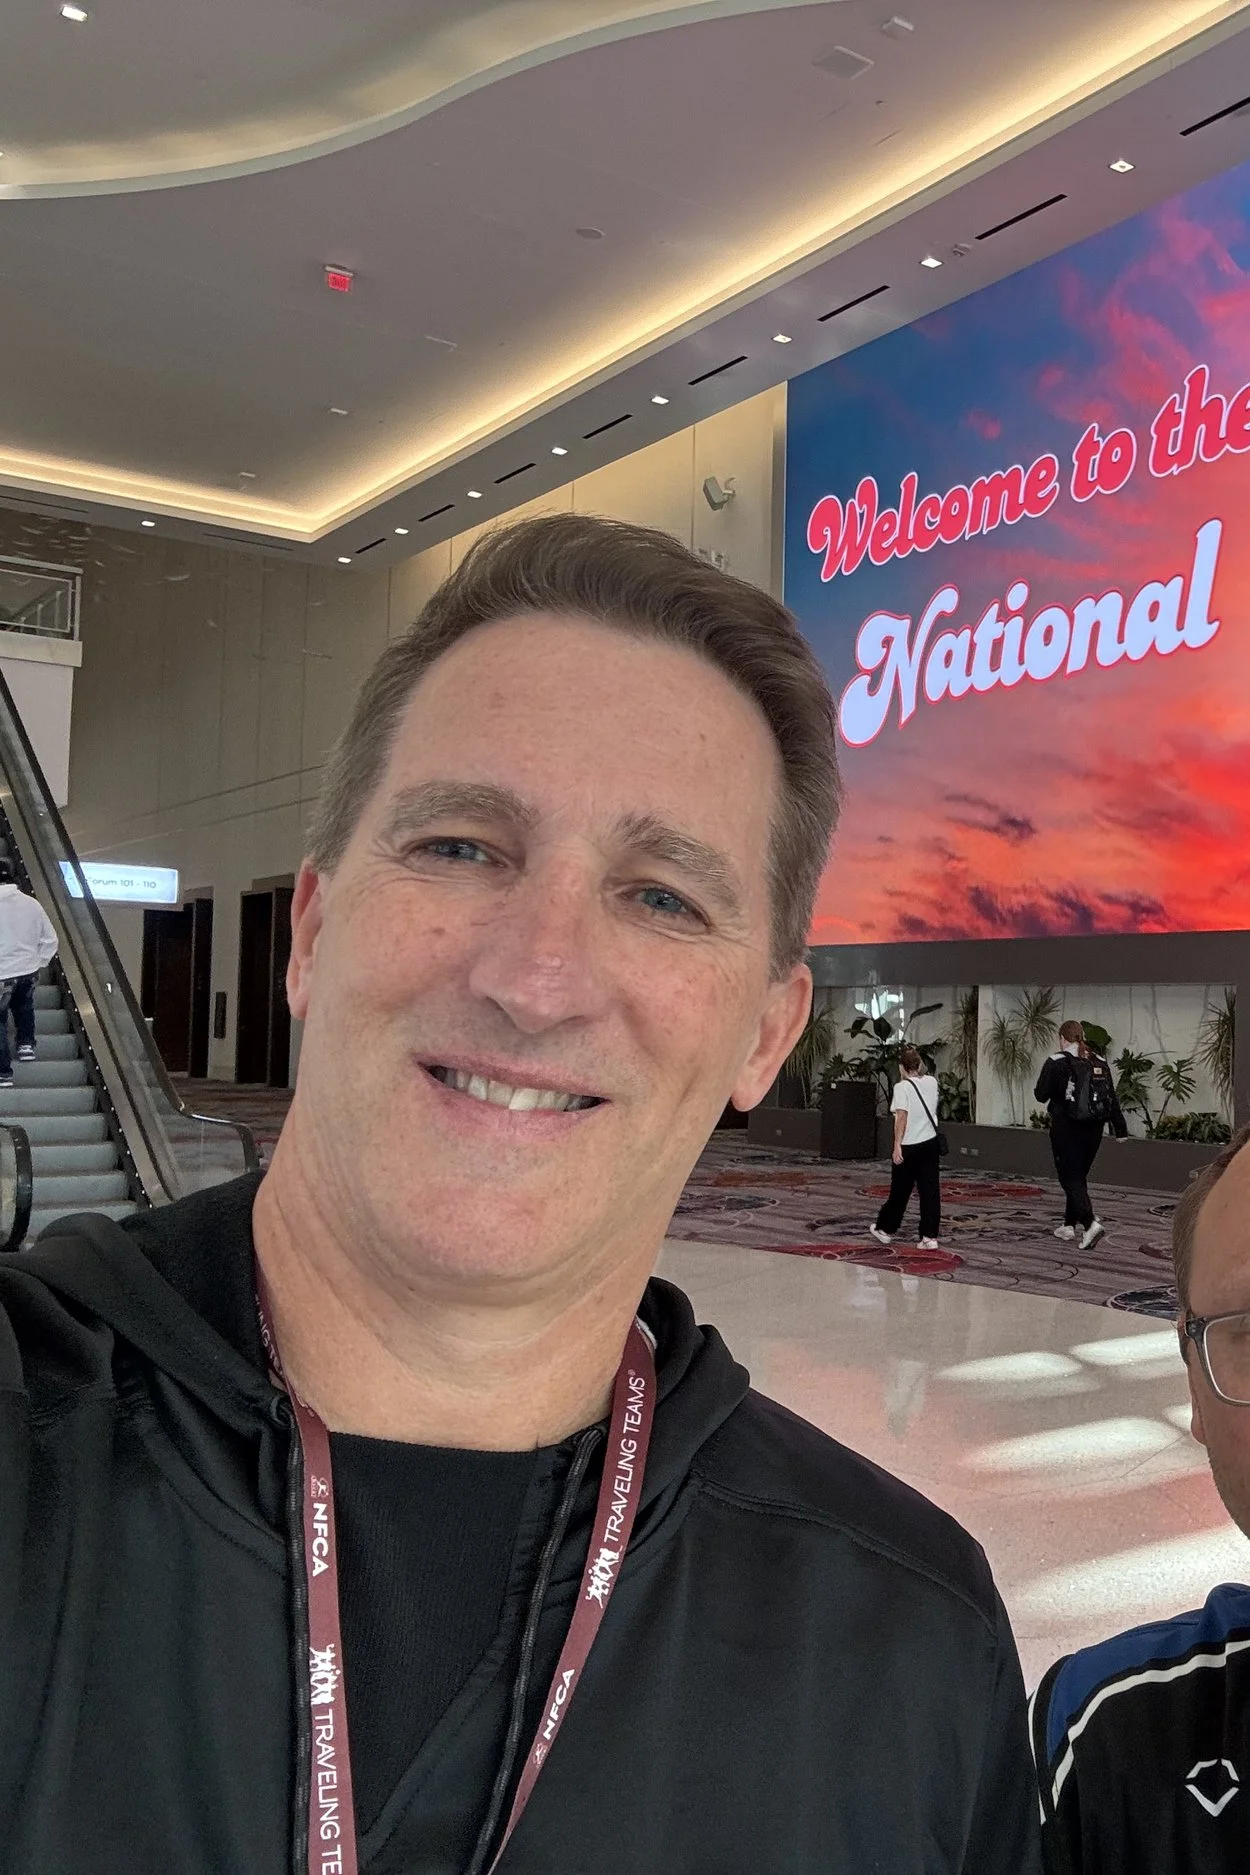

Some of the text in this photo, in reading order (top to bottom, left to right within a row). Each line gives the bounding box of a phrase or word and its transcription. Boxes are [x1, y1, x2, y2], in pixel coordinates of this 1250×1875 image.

[807, 453, 1060, 583] Welcome
[1071, 423, 1137, 503] to
[839, 517, 1225, 749] National
[120, 879, 134, 887] 101
[143, 880, 157, 889] 110
[312, 1502, 329, 1577] NFCA
[604, 1438, 637, 1543] TRAVELING
[543, 1668, 576, 1741] NFCA
[314, 1708, 341, 1841] TRAVELING
